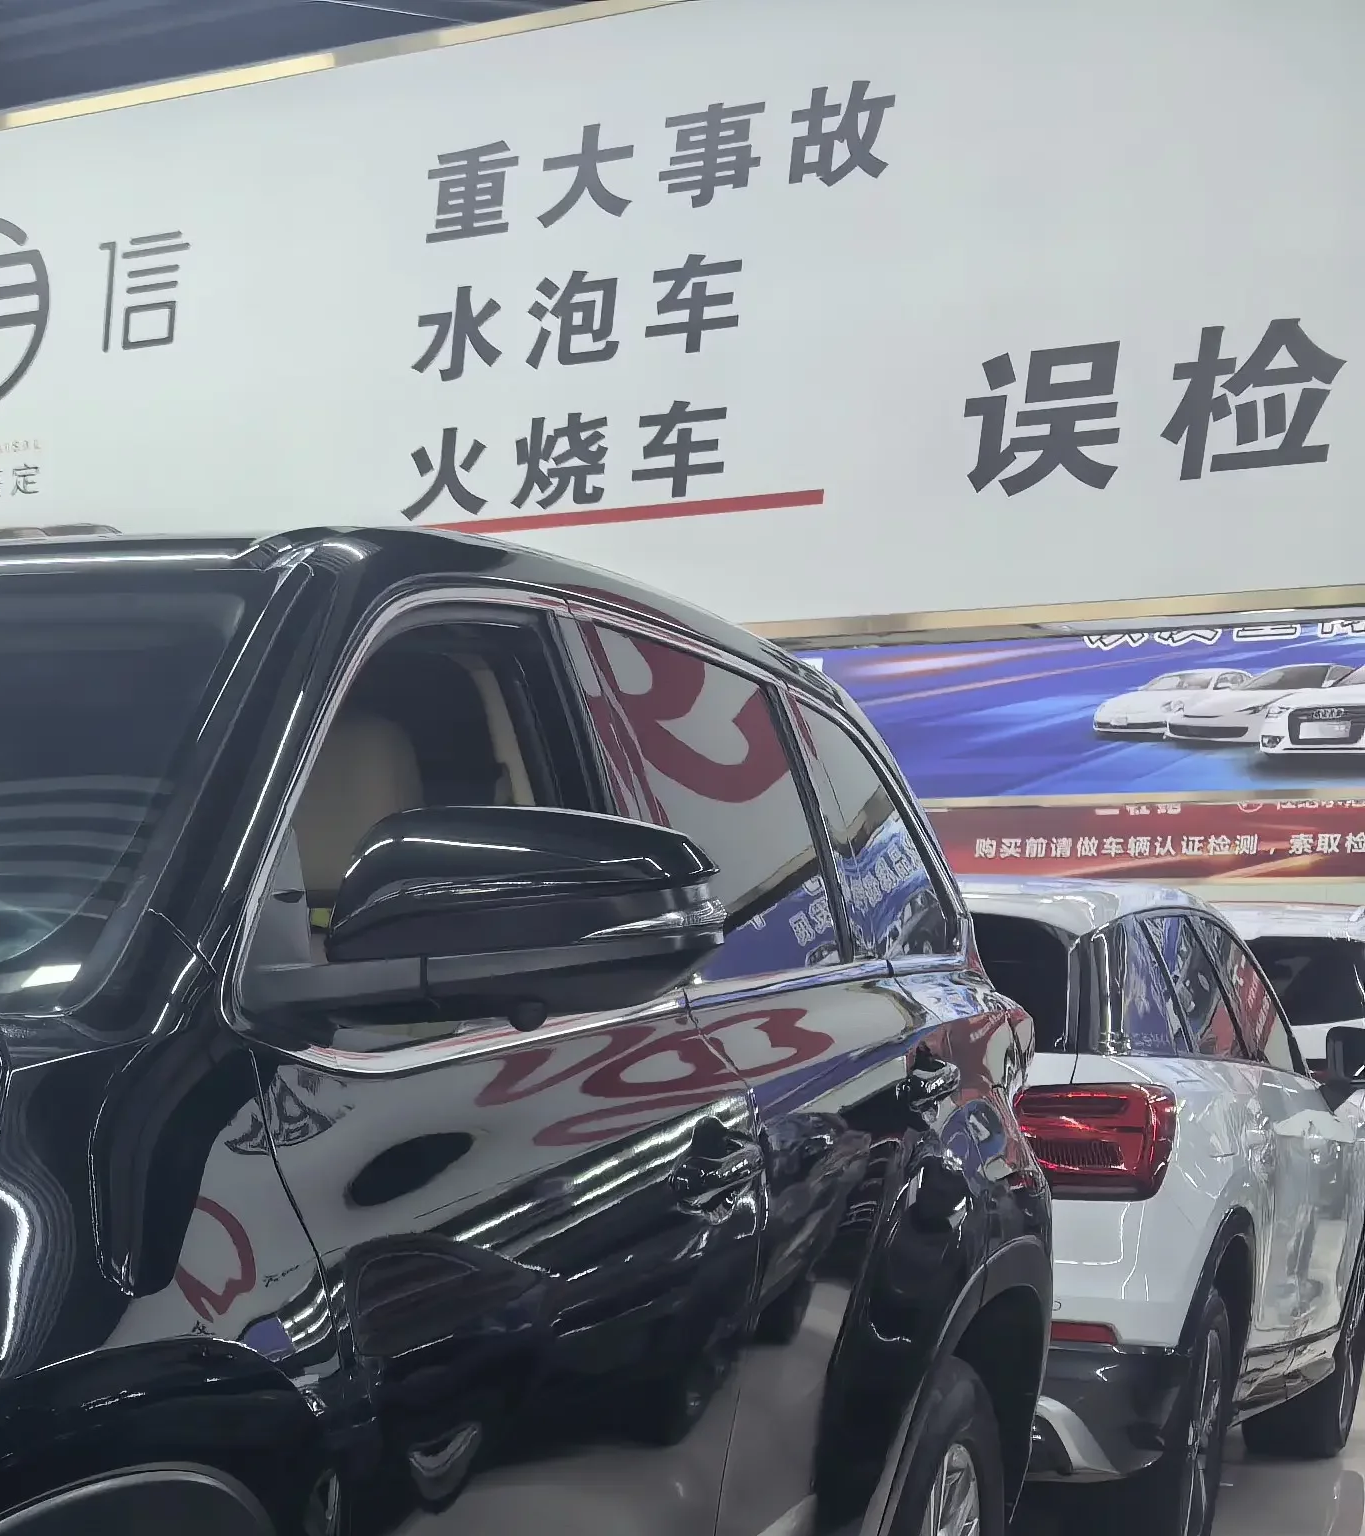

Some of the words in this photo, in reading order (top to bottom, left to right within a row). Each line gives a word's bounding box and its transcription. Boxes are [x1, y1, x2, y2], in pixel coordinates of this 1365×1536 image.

[425, 79, 896, 244] 重大事故
[98, 229, 192, 354] 信
[411, 253, 743, 383] 水泡车
[400, 399, 728, 522] 火烧车
[963, 317, 1348, 499] 误检
